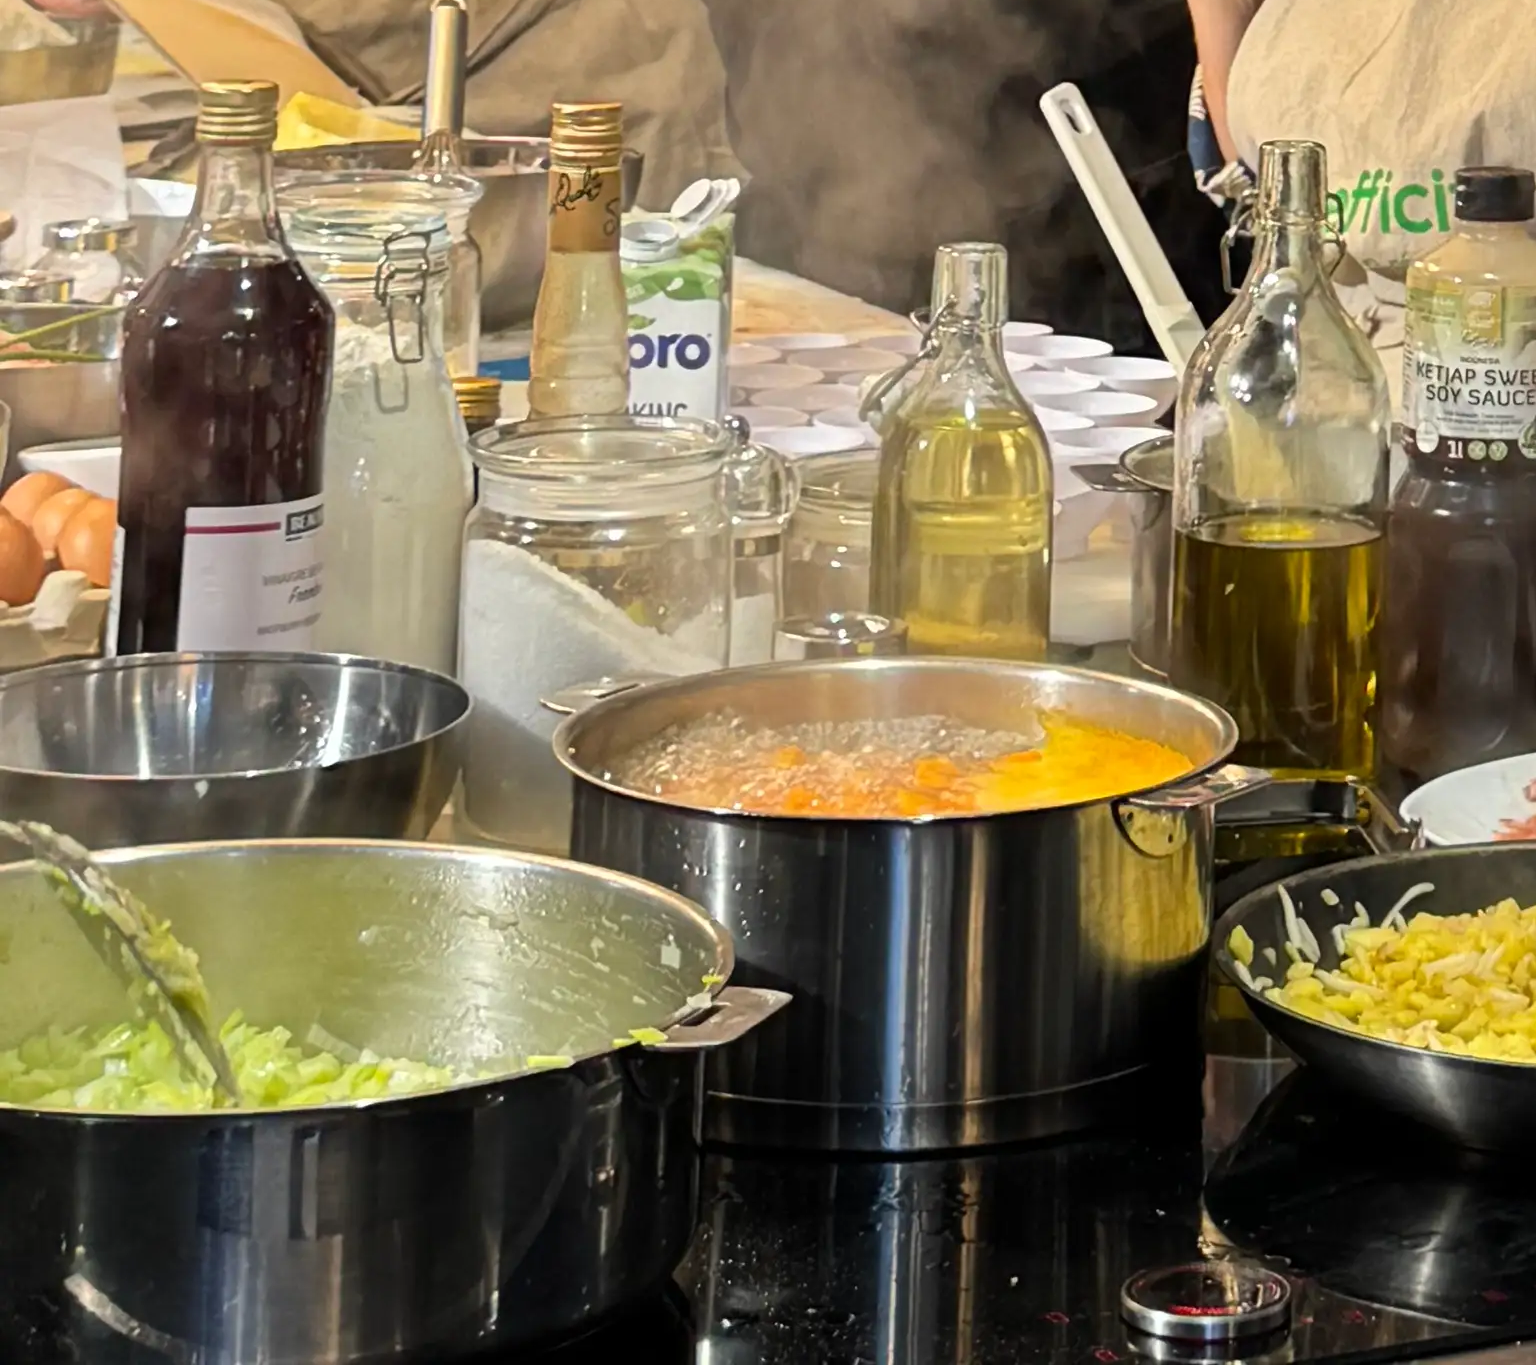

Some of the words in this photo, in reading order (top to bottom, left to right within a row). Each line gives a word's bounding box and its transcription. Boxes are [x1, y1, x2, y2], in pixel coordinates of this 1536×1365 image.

[1416, 360, 1477, 386] KETJAP
[1425, 383, 1462, 404] SOY
[1467, 388, 1536, 407] SAUCE
